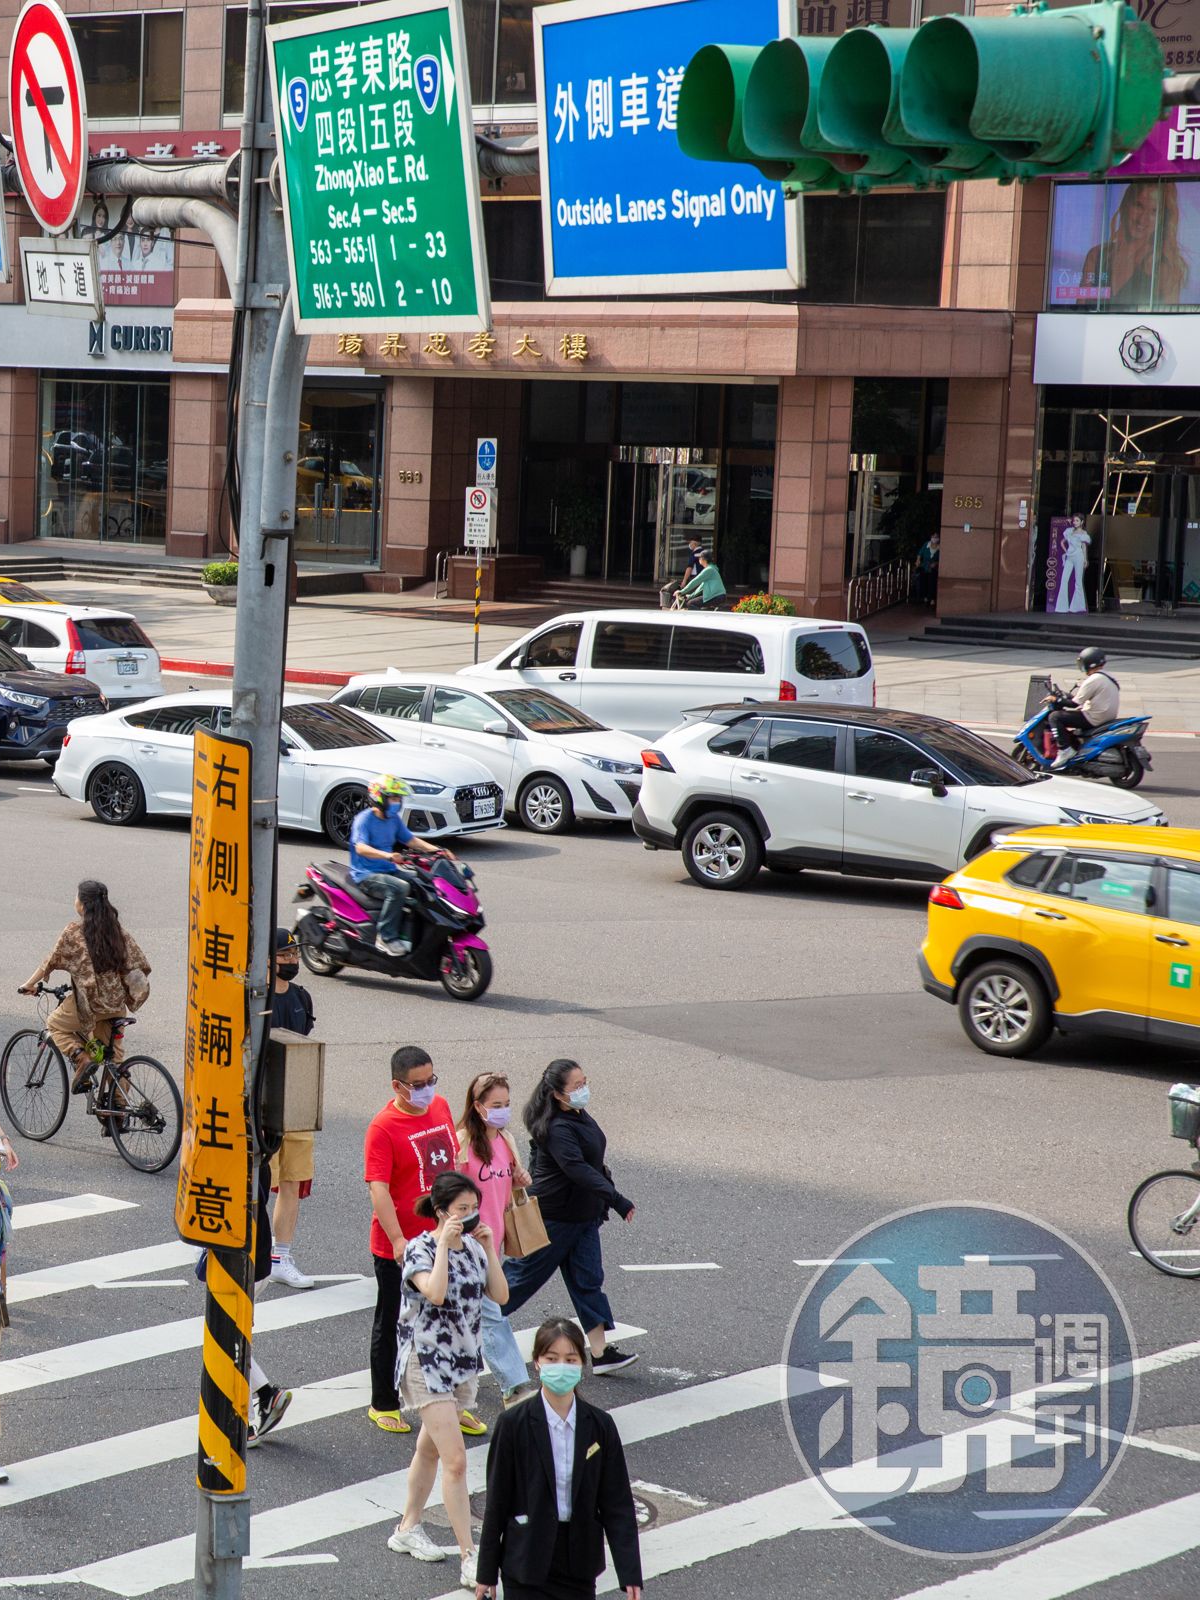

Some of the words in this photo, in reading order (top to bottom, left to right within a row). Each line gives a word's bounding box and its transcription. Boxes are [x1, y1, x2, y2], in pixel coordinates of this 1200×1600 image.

[309, 29, 414, 104] 忠孝東路
[422, 66, 434, 94] 5
[294, 88, 303, 113] 5
[553, 65, 685, 144] 外側車道
[315, 106, 358, 158] 四段
[368, 100, 416, 153] 五段
[314, 162, 385, 197] ZhongXiao
[387, 158, 403, 184] E.
[404, 154, 429, 183] Rd.
[328, 202, 361, 230] Sec.4
[382, 197, 417, 226] Sec.5
[557, 196, 612, 228] Outside
[615, 193, 667, 223] Lanes
[671, 186, 726, 228] Signal
[730, 183, 776, 221] Only
[36, 260, 88, 297] 地下道
[111, 325, 173, 352] CURIST
[337, 331, 589, 360] 揚昇忠孝大樓
[953, 495, 983, 509] 565
[188, 754, 240, 1234] 右側車輛注意
[408, 1130, 426, 1141] UNDER
[426, 1123, 448, 1135] ARMOUR
